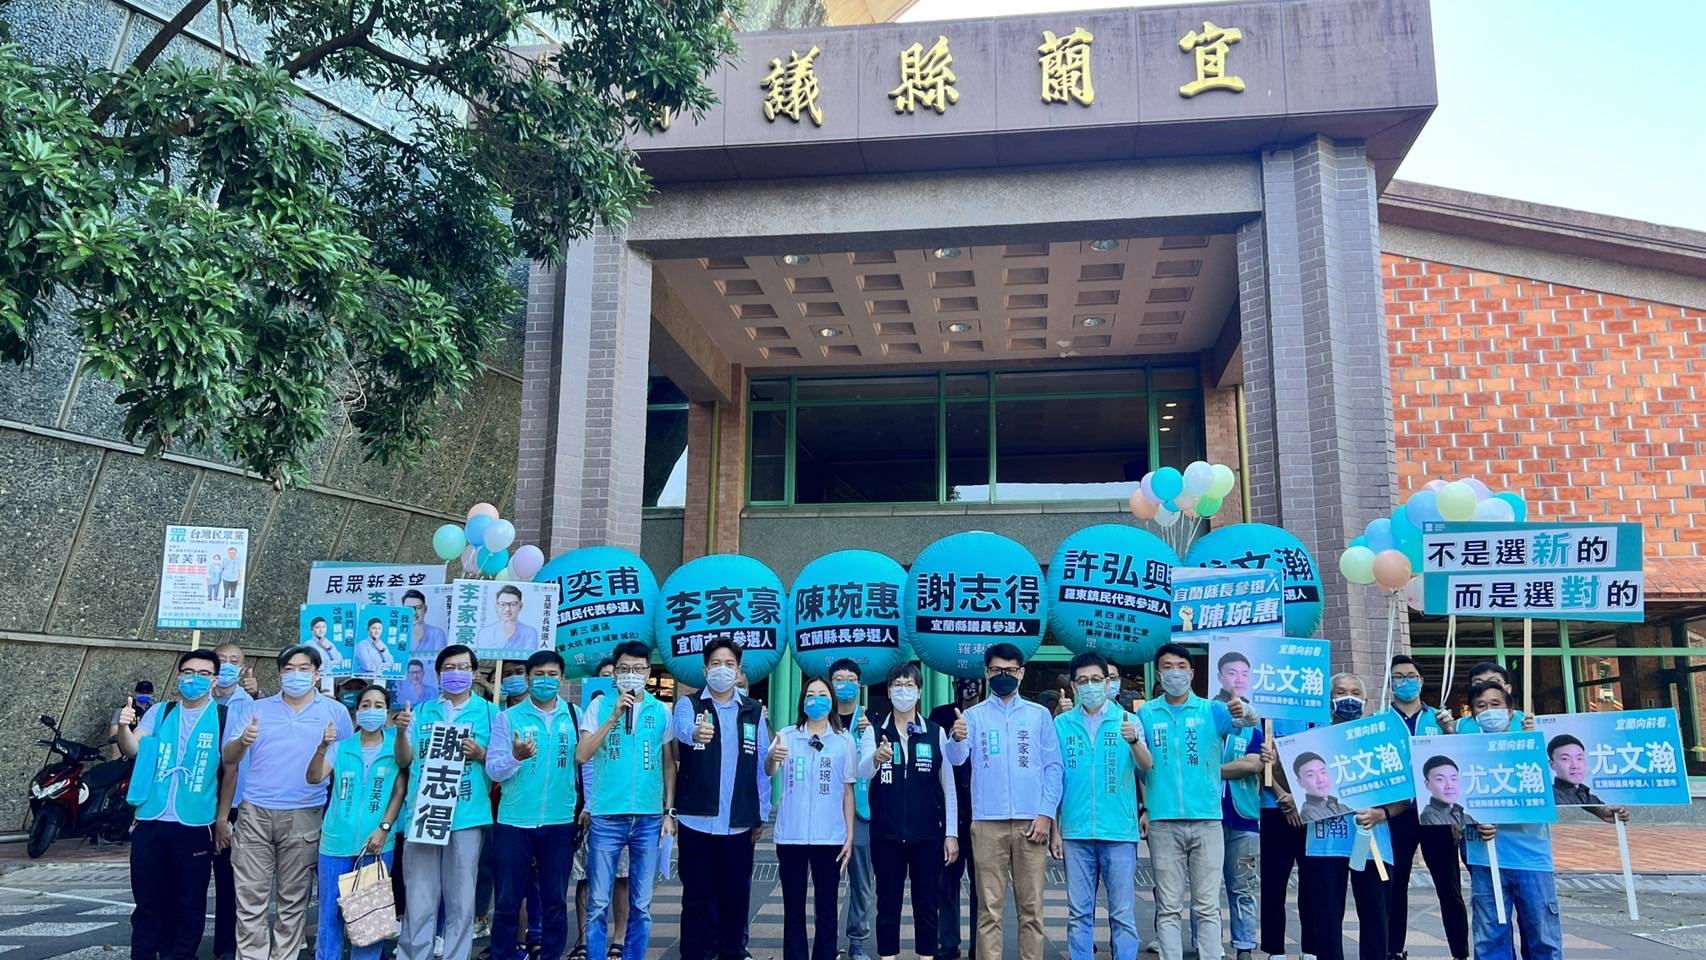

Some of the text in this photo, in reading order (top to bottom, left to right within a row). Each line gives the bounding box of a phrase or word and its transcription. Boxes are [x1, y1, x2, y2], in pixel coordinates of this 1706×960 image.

[650, 22, 1246, 130] 宜蘭縣議
[190, 529, 244, 540] 台灣民眾黨
[1427, 532, 1608, 567] 不是選新的
[1063, 550, 1172, 597] 許弘興
[1201, 547, 1314, 582] 文瀚
[325, 572, 426, 594] 民眾新希望
[917, 572, 1040, 614] 謝志得
[1455, 575, 1638, 609] 而是選對的
[456, 583, 480, 645] 李家豪
[558, 601, 640, 622] 鎮民代表參選人
[666, 586, 781, 632] 李家豪
[795, 582, 900, 625] 陳琬惠
[1064, 587, 1169, 615] 羅東鎮民代表參選人
[1198, 597, 1280, 629] 陳琬惠
[800, 628, 895, 647] 宜蘭縣長參選人
[958, 642, 992, 654] 羅東
[1253, 664, 1324, 696] 尤文瀚
[1185, 729, 1199, 766] 尤文瀚
[1329, 742, 1403, 785] 尤文瀚
[1588, 741, 1677, 775] 尤文瀚
[415, 726, 470, 840] 謝志得
[1462, 762, 1544, 795] 尤文瀚
